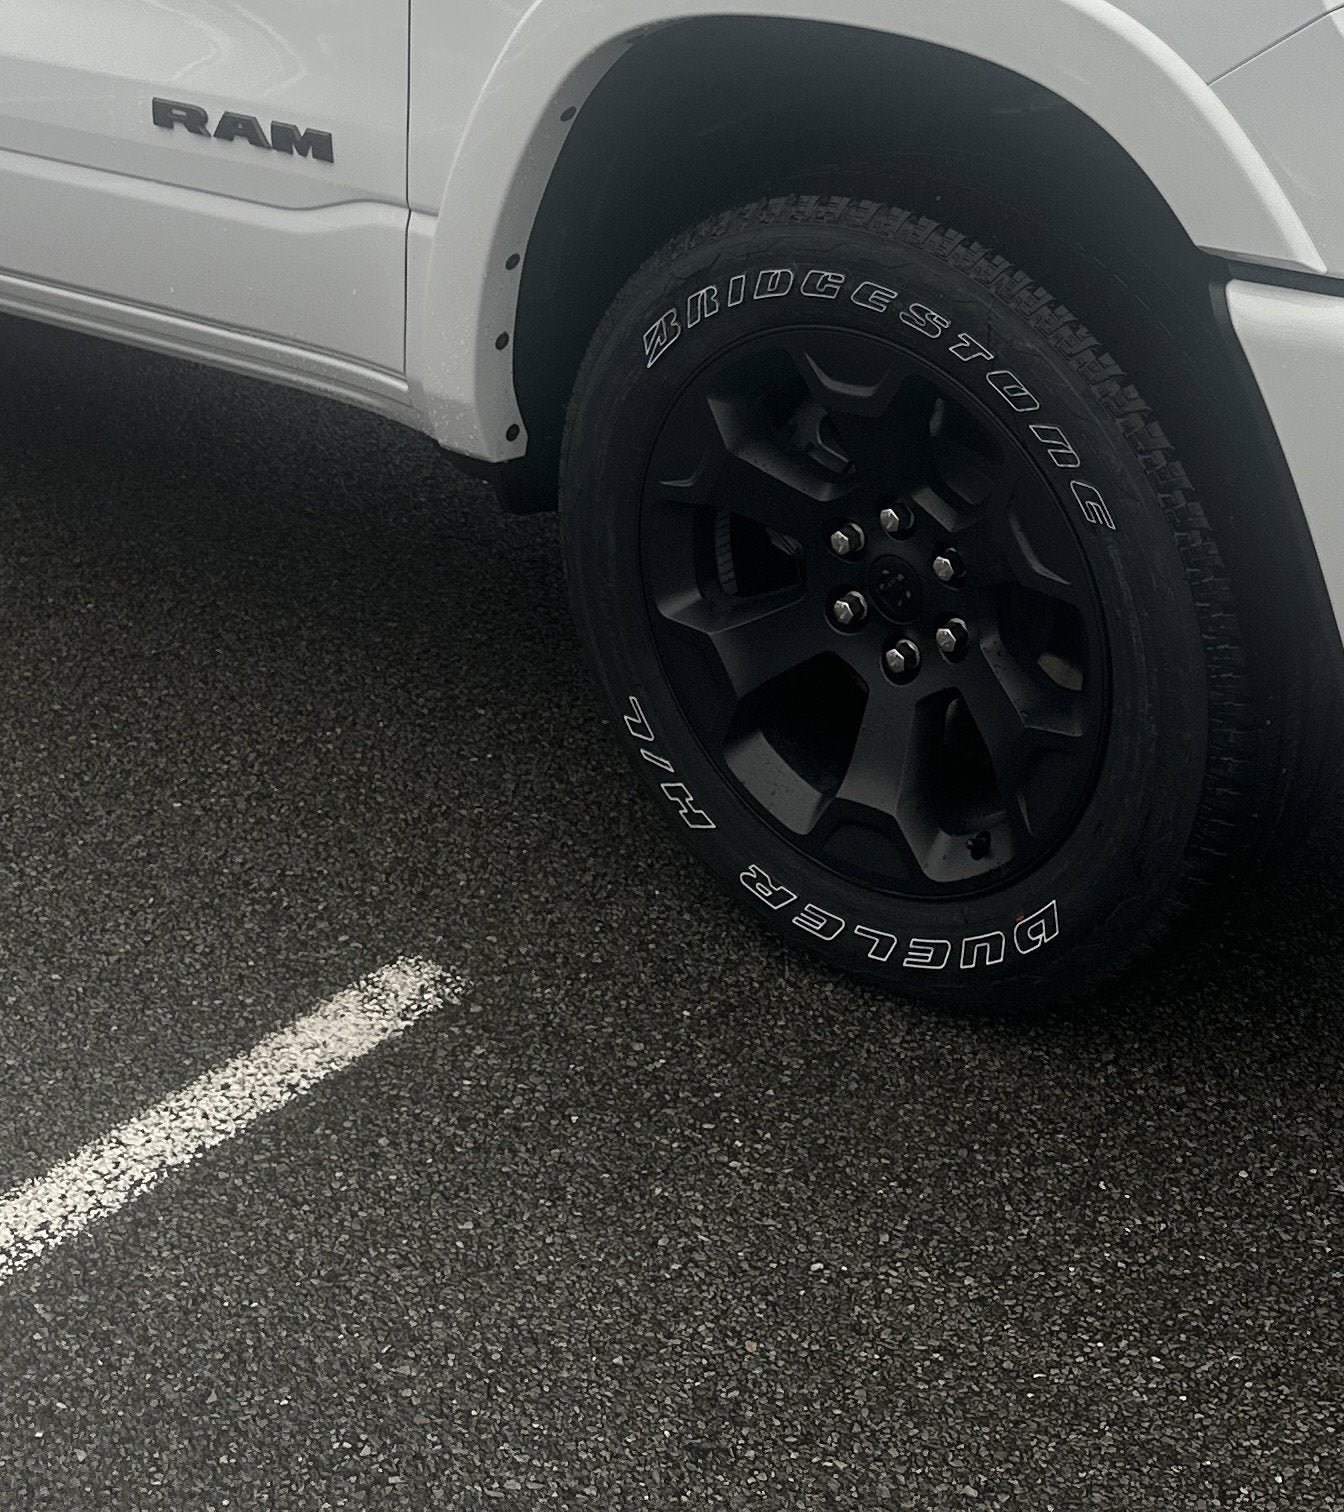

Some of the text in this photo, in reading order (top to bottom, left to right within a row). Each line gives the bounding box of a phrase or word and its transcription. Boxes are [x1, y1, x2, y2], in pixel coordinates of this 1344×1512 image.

[151, 97, 334, 163] RAM
[642, 269, 1117, 530] BRIDGESTONE
[624, 696, 1061, 969] DUELER H/L
